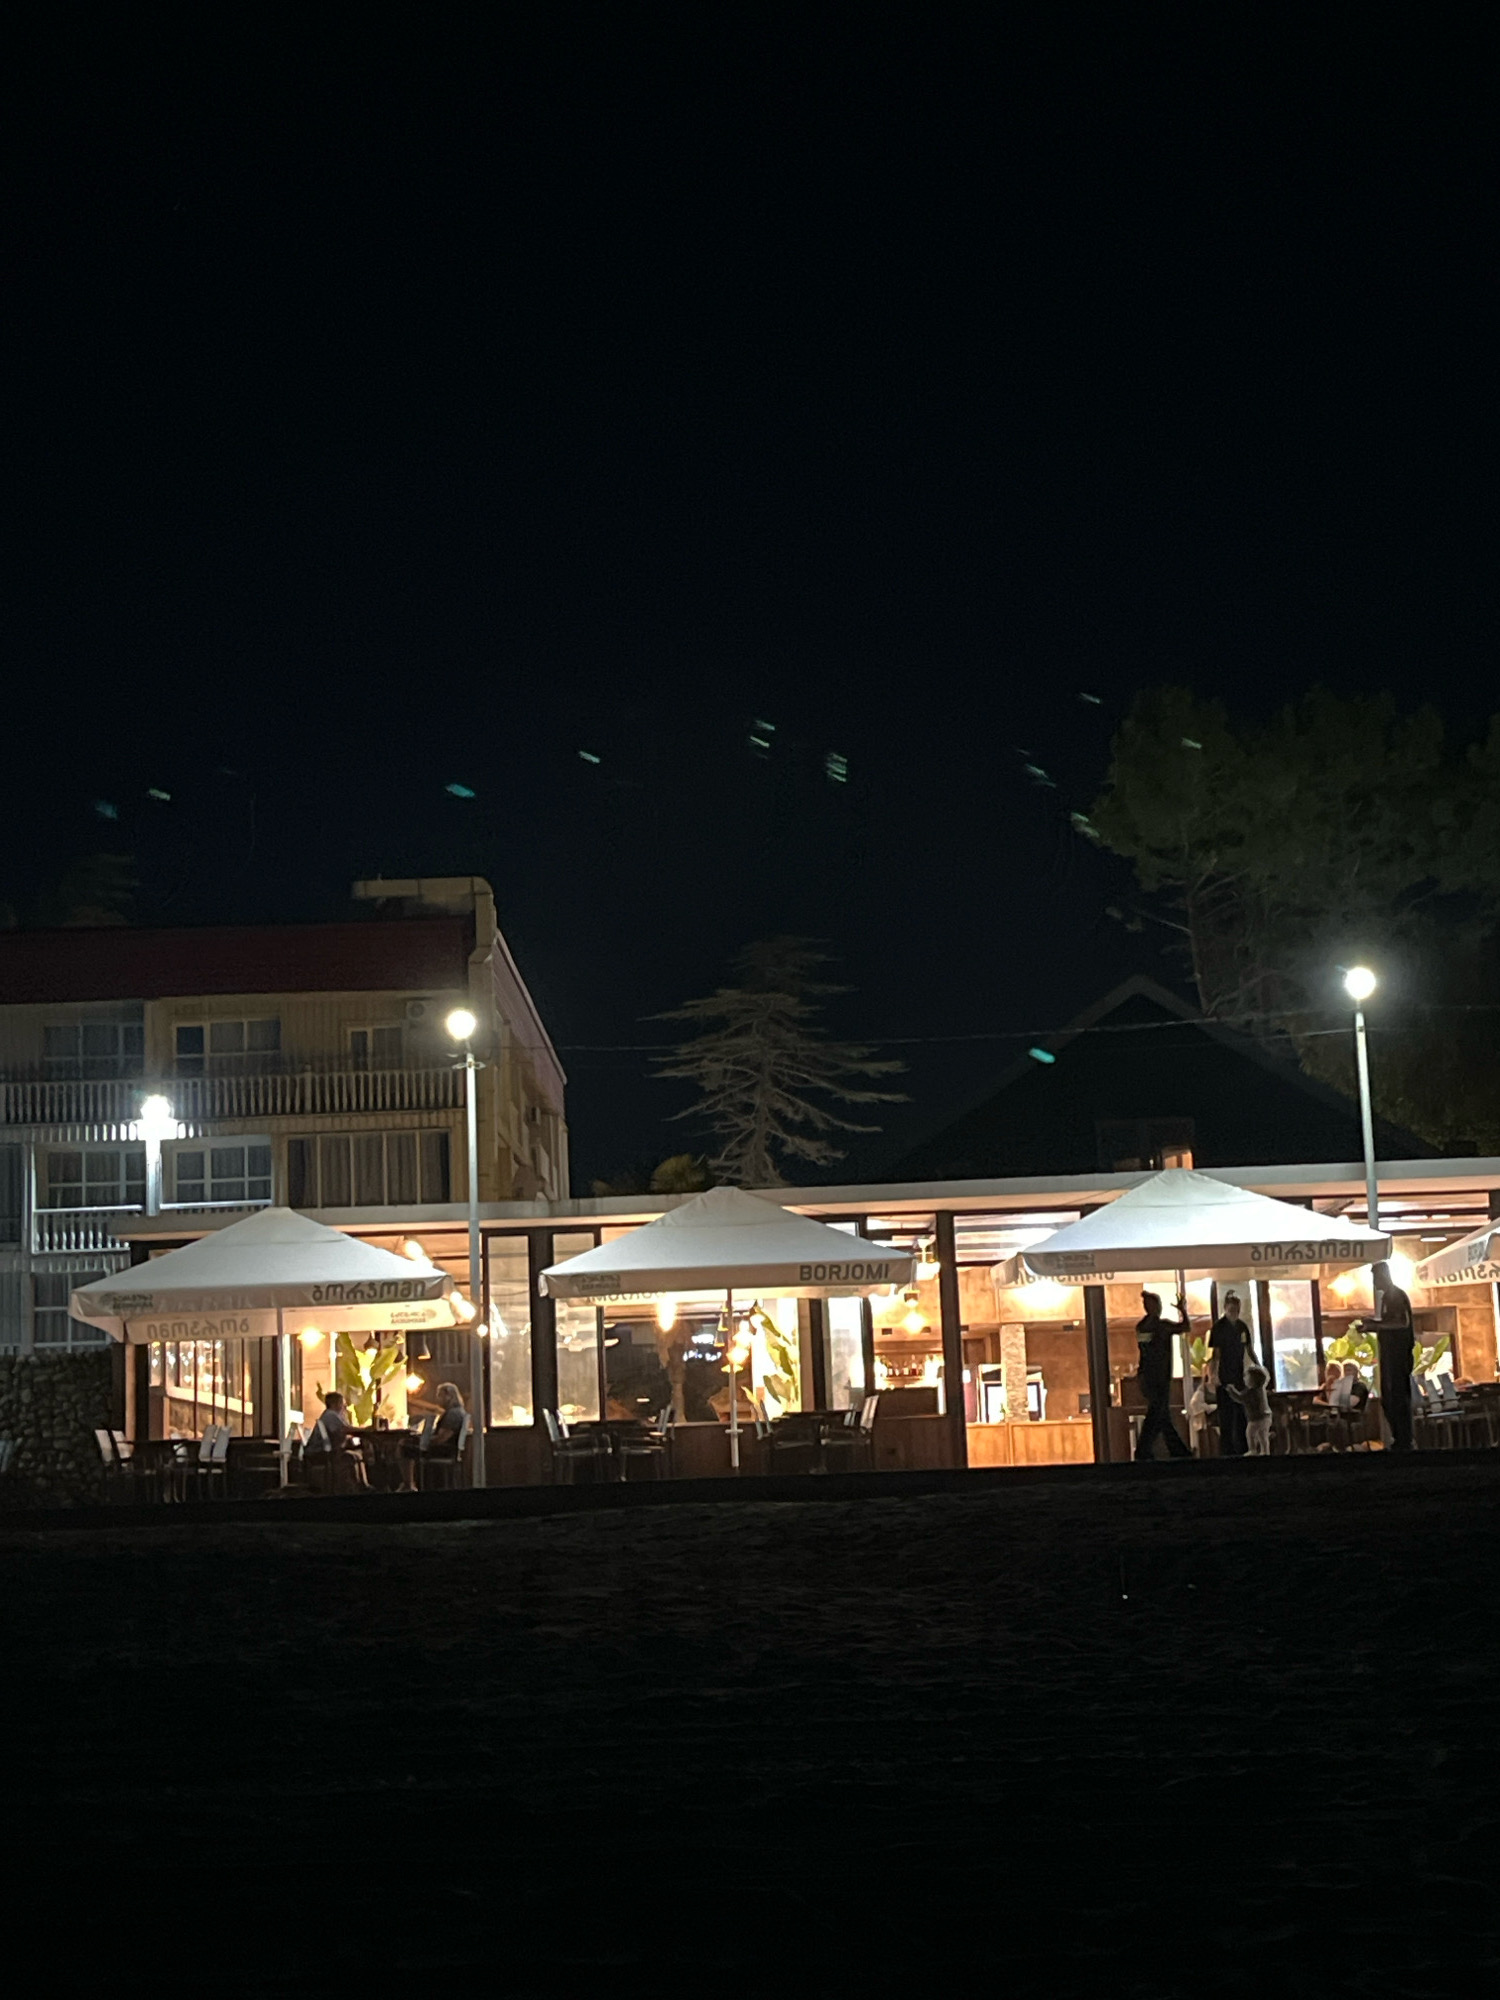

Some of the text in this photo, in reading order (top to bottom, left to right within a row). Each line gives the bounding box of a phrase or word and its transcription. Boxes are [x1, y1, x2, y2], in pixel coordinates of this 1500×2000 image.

[1251, 1241, 1364, 1261] ბორჯომი
[799, 1263, 889, 1281] BORJOMI
[312, 1280, 426, 1301] ბორჯომი
